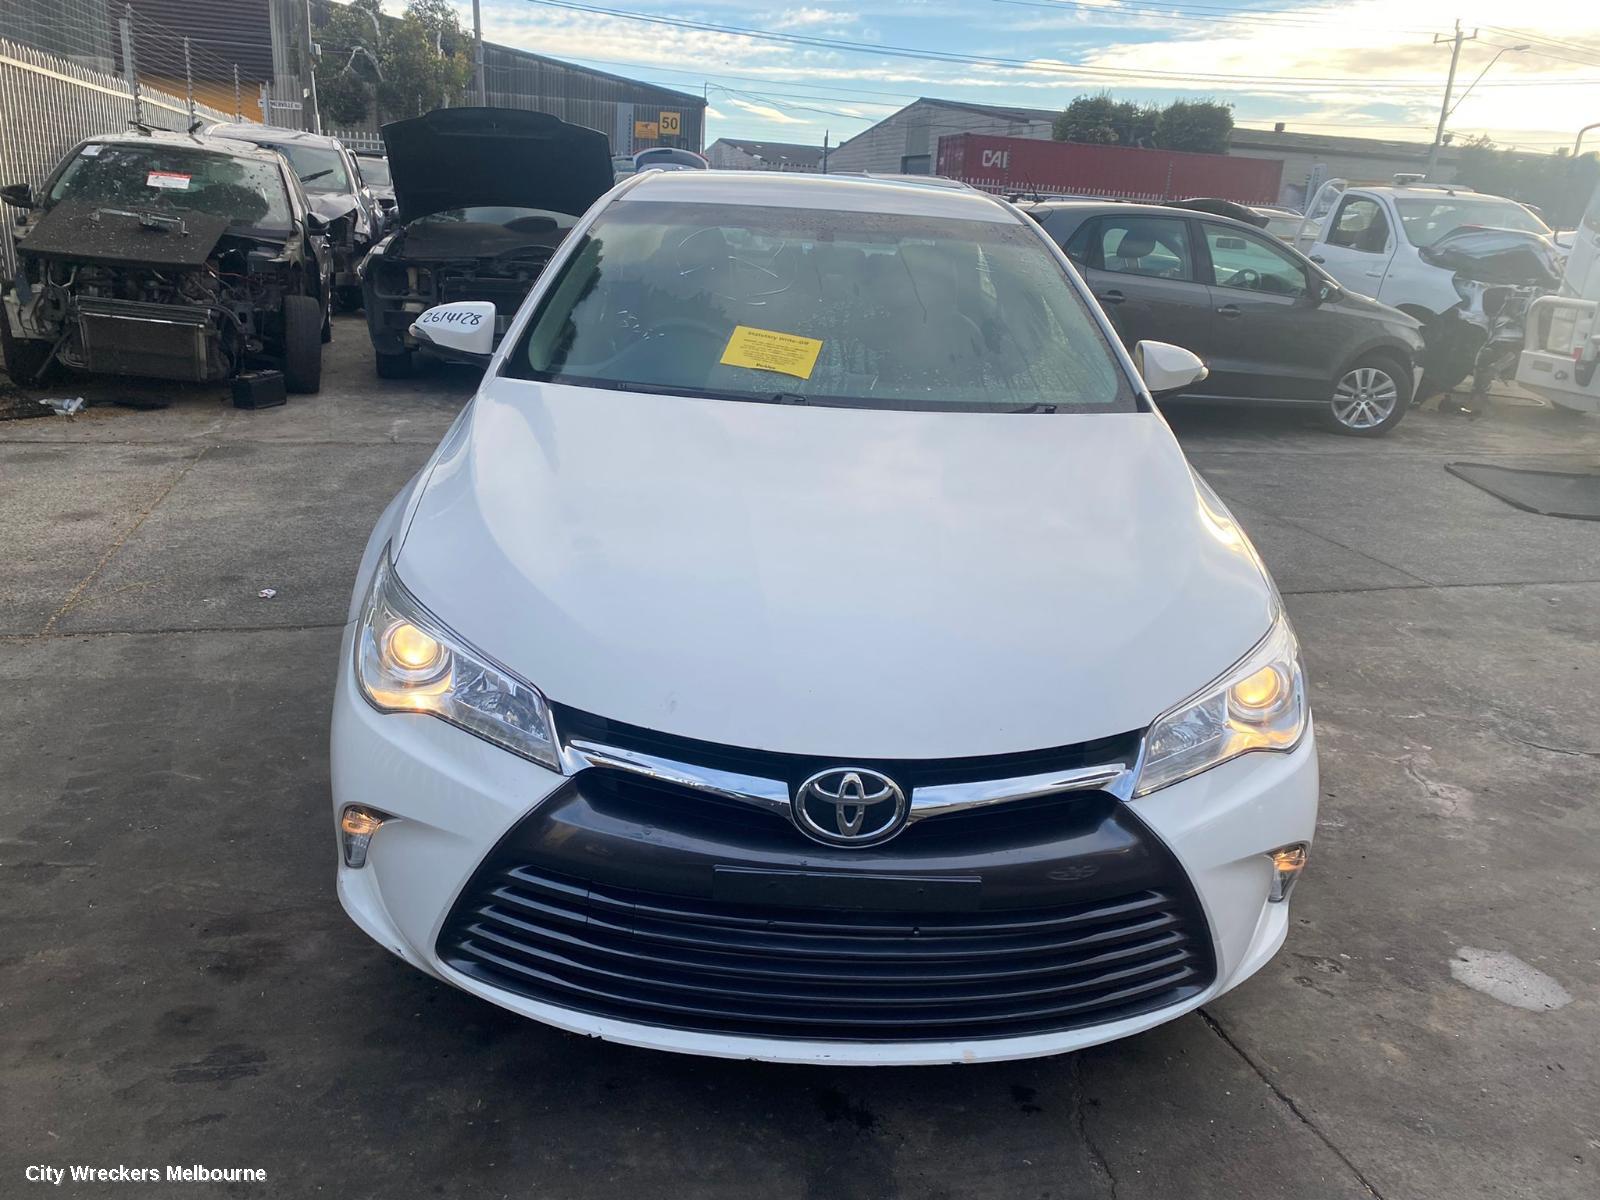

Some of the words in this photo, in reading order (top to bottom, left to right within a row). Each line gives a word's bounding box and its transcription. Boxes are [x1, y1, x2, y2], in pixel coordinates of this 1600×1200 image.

[662, 116, 678, 130] 50
[982, 150, 1008, 168] CAI
[423, 311, 483, 326] 2614128
